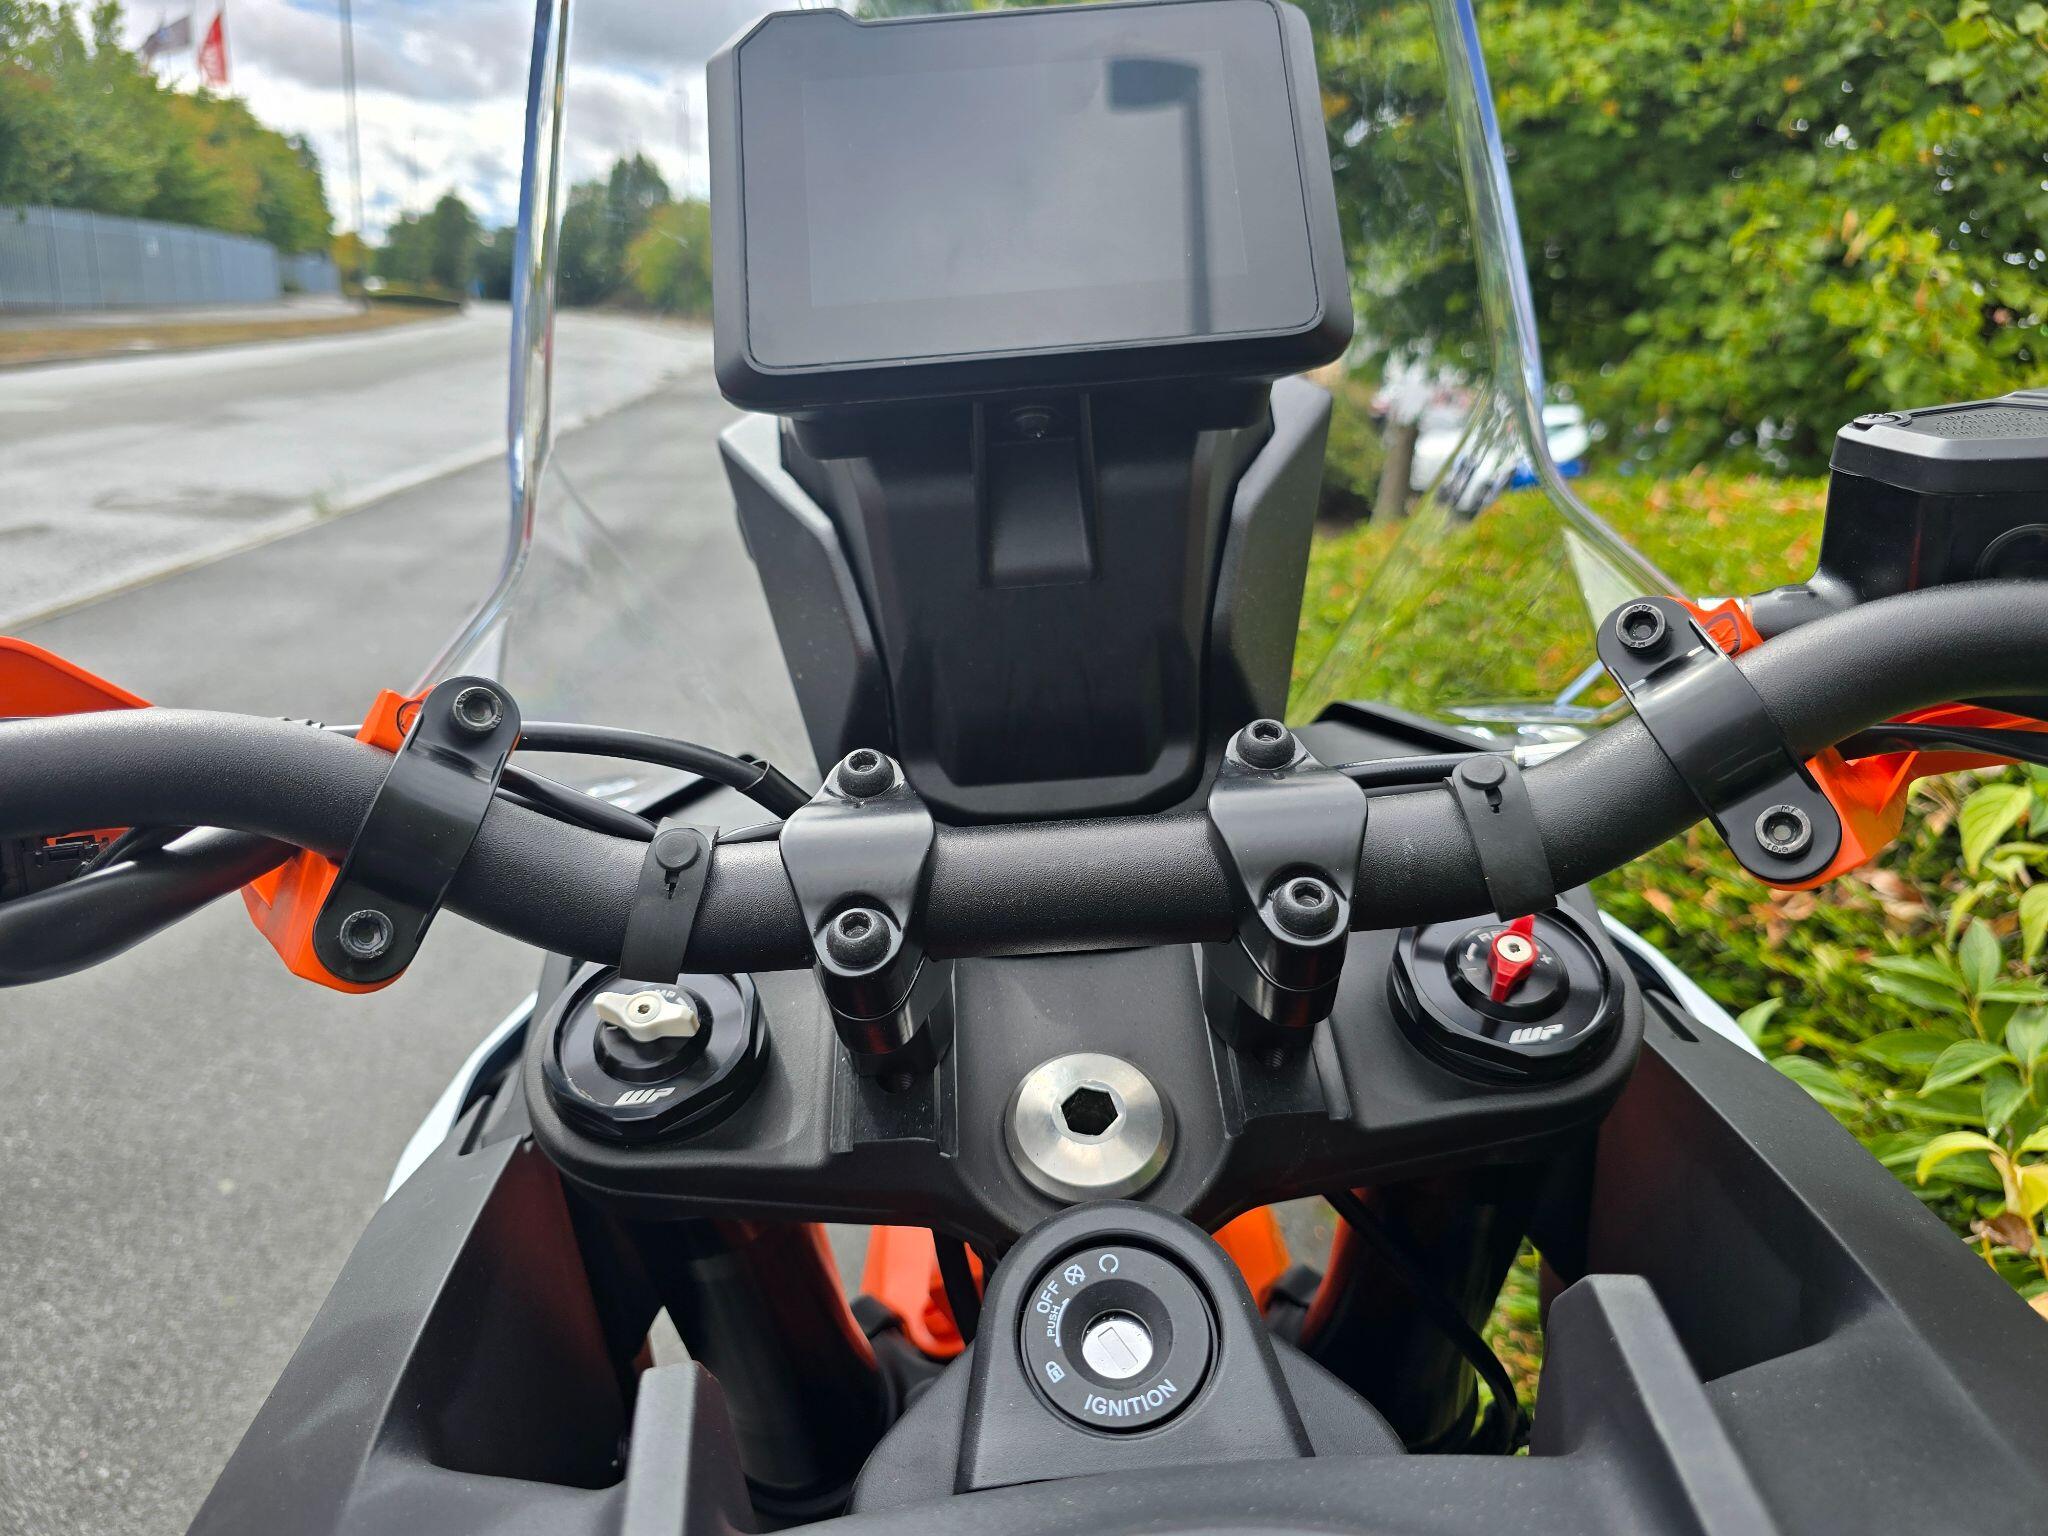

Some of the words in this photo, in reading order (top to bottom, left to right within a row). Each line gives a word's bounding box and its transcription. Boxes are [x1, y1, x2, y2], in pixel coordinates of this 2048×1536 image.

[1509, 1023, 1564, 1044] WP
[614, 1087, 676, 1106] WP
[1036, 1280, 1059, 1314] OFF
[1046, 1305, 1061, 1337] PUSH
[1083, 1378, 1178, 1416] IGNITION
